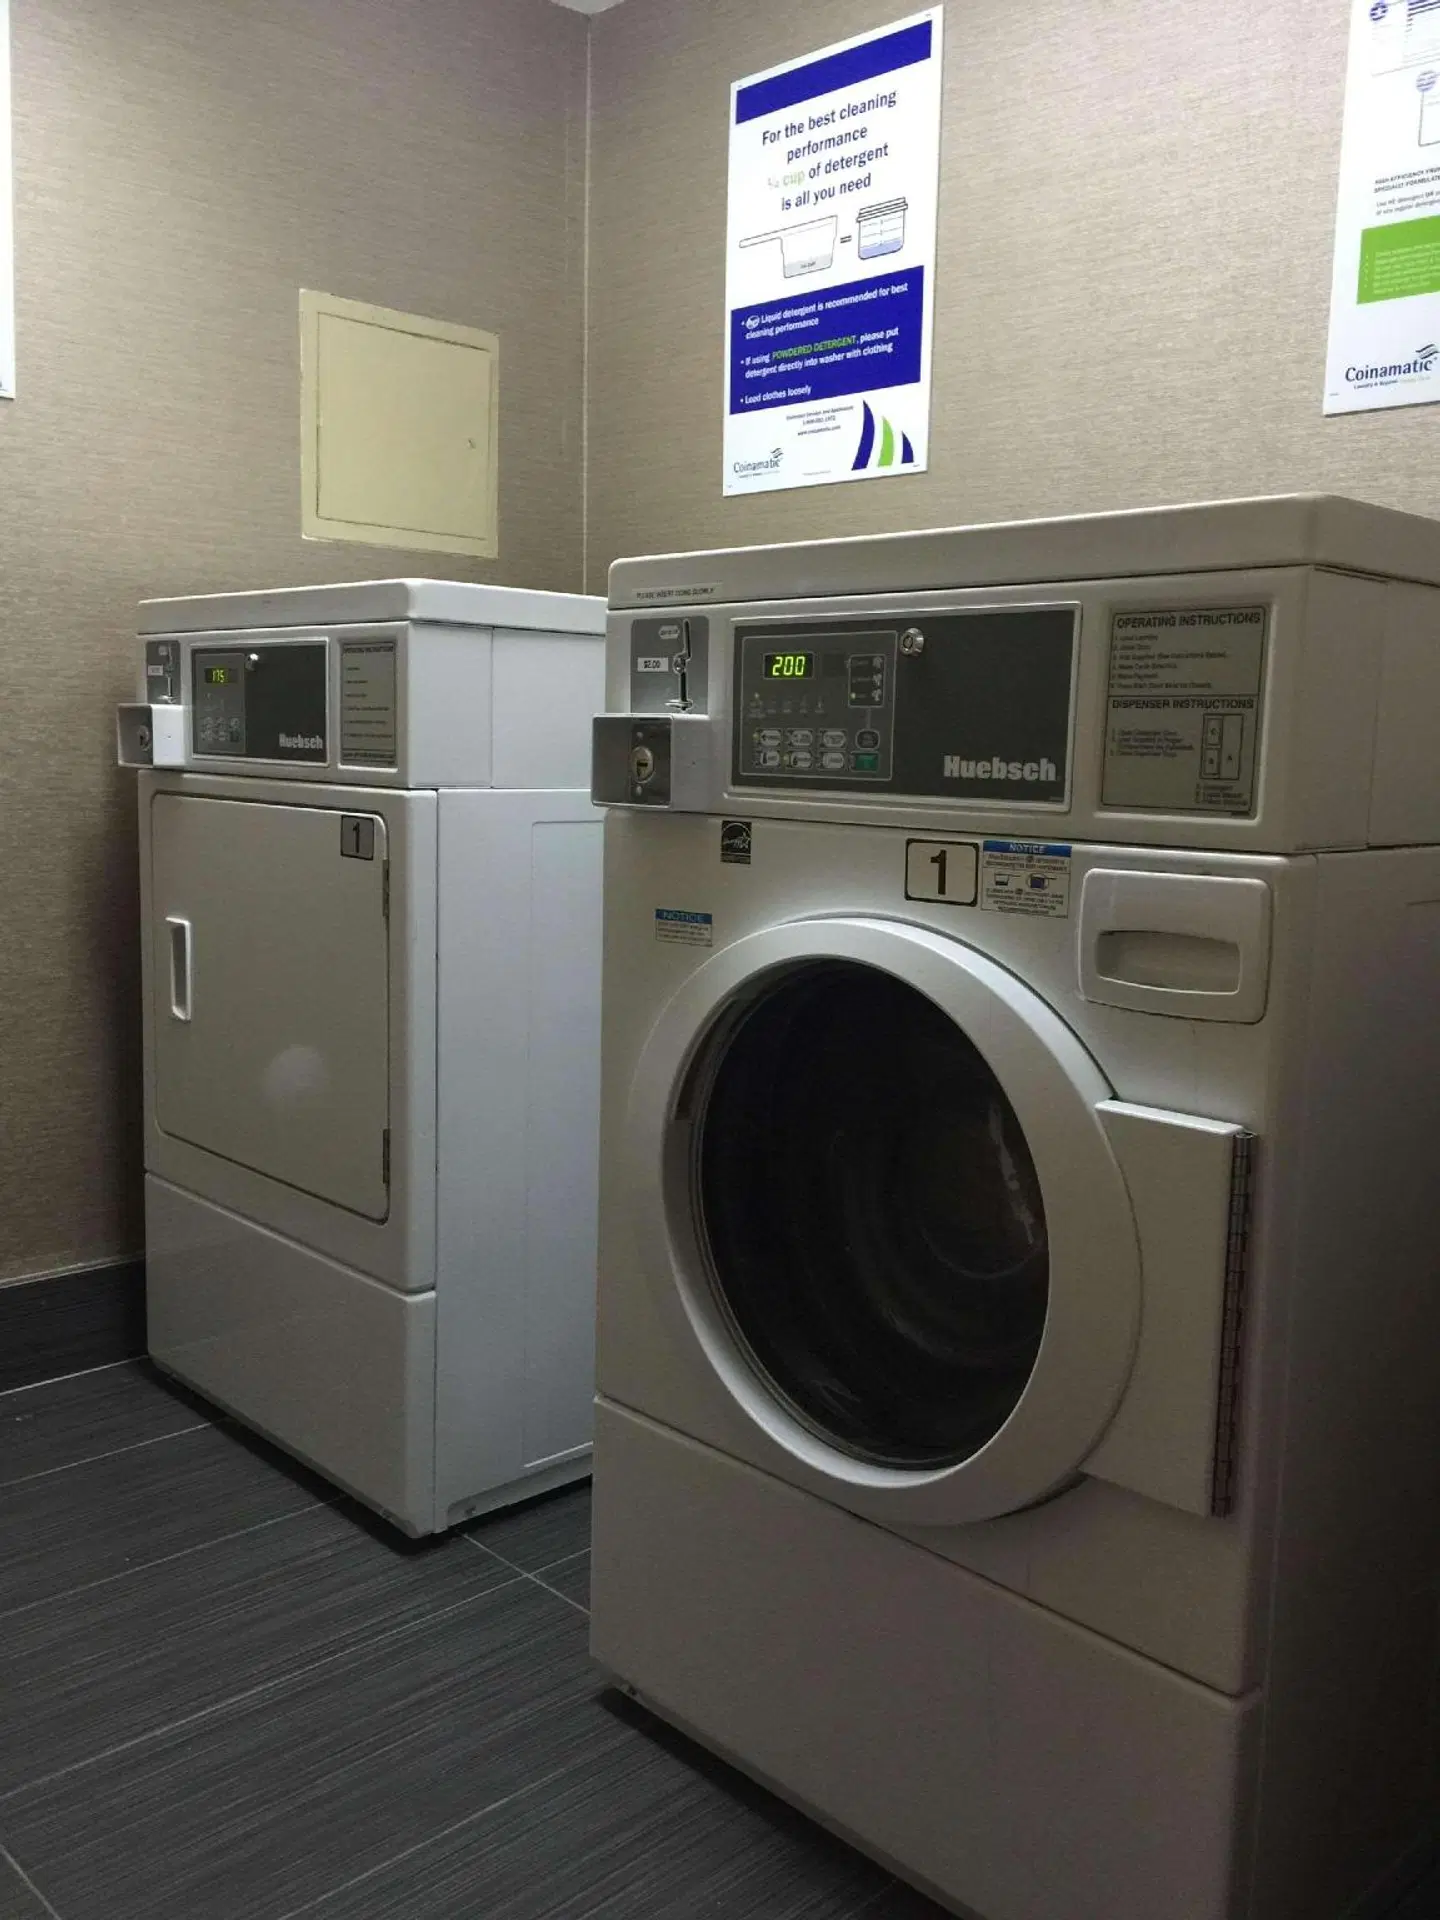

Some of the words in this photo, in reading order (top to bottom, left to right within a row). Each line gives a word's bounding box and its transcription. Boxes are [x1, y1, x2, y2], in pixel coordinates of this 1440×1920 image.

[762, 128, 781, 146] For
[784, 120, 804, 139] the
[808, 110, 836, 131] best
[839, 90, 897, 120] cleaning
[787, 125, 868, 164] performance
[783, 170, 805, 187] cup
[808, 162, 821, 180] of
[824, 142, 889, 175] detergent
[781, 197, 792, 212] is
[795, 190, 810, 208] all
[813, 185, 835, 206] you
[839, 172, 872, 195] need
[761, 311, 783, 325] Liquid
[782, 304, 817, 321] detergent
[818, 302, 824, 312] is
[825, 290, 878, 310] recommended
[878, 286, 890, 298] for
[891, 282, 909, 294] best
[745, 327, 774, 340] cleaning
[775, 317, 819, 335] performance
[752, 352, 771, 366] using
[772, 344, 813, 360] POWDERED
[859, 331, 885, 344] please
[885, 327, 899, 340] put
[745, 365, 778, 379] detergent
[778, 359, 803, 373] directly
[804, 356, 818, 369] into
[819, 352, 845, 366] washer
[846, 348, 861, 360] with
[862, 342, 894, 357] clothing
[1345, 358, 1433, 382] Coinamatic
[745, 393, 761, 404] Load
[762, 388, 787, 402] clothes
[787, 384, 812, 398] loosely
[733, 458, 781, 475] Coinamatic
[1117, 616, 1177, 629] OPERATING
[1179, 612, 1261, 626] INSTRUCTIONS
[772, 656, 805, 676] 200
[1112, 699, 1170, 709] DISPENSER
[1172, 699, 1254, 709] INSTRUCTIONS
[279, 733, 323, 750] Huebsch
[943, 754, 1057, 781] Huebsch
[352, 822, 361, 854] 1
[1008, 843, 1046, 854] NOTICE
[930, 849, 948, 895] 1
[663, 911, 705, 923] NOTICE
